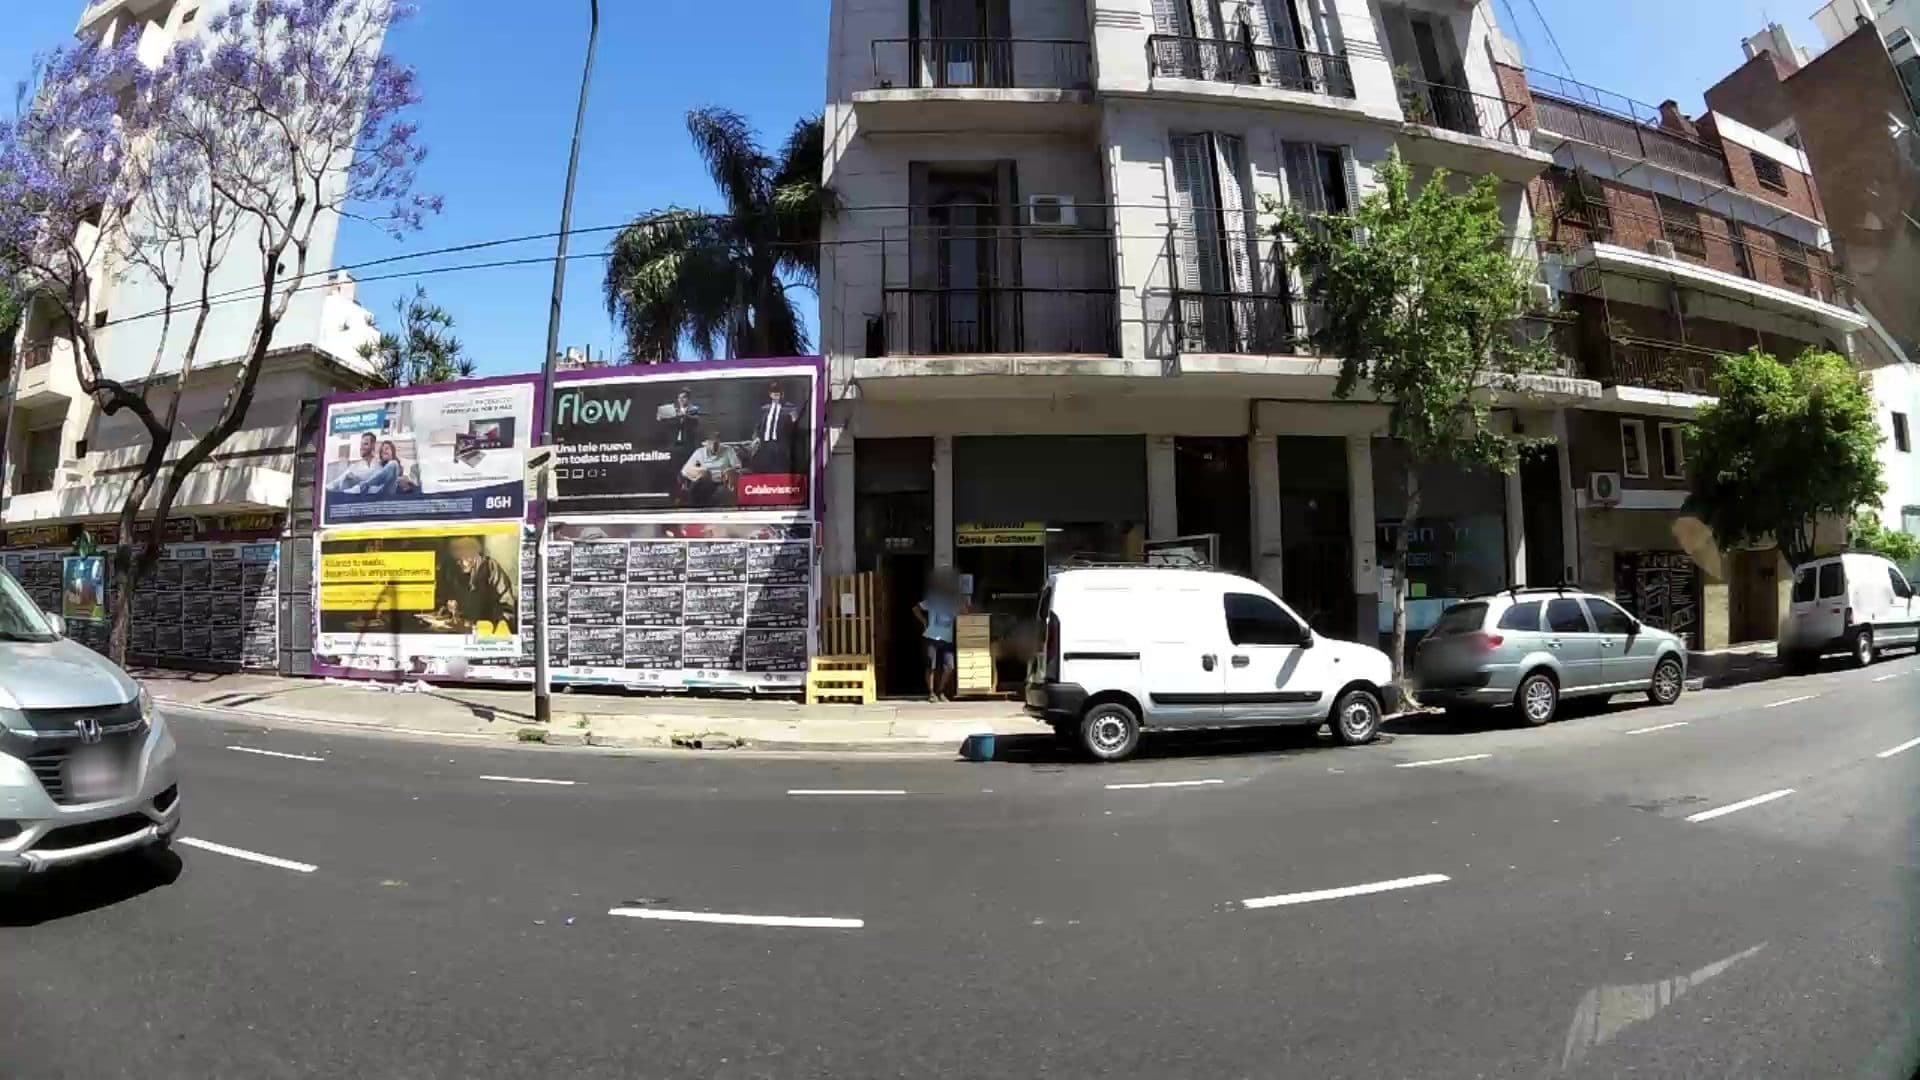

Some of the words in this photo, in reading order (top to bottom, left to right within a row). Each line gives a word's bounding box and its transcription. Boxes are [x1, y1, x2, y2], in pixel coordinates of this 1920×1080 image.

[557, 394, 632, 425] flow
[557, 443, 577, 454] Una
[578, 442, 599, 452] tele
[600, 442, 632, 451] nueva
[570, 454, 600, 464] todas
[601, 453, 619, 463] tus
[620, 450, 672, 464] pantallas
[486, 496, 512, 508] BGH
